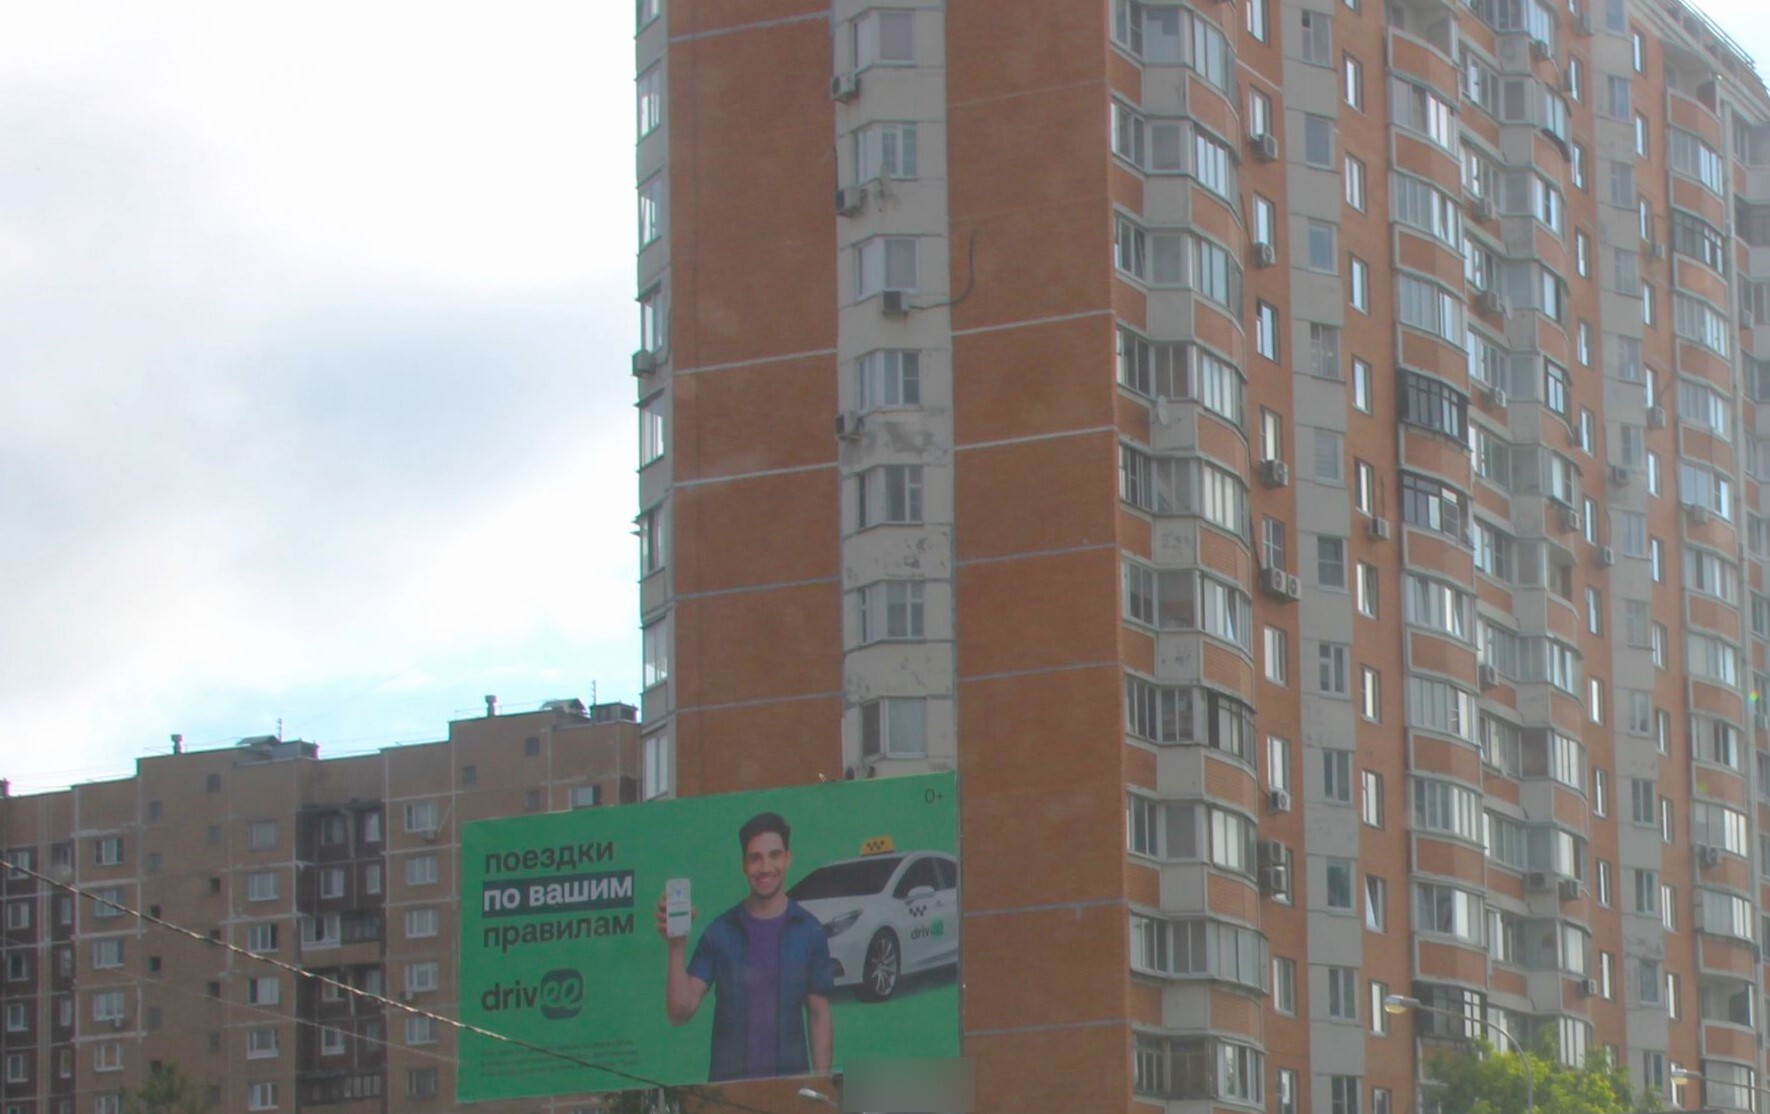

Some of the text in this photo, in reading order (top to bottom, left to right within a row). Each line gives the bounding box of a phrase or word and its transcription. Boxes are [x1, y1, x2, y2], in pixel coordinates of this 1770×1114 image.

[484, 841, 614, 875] поездки
[483, 876, 633, 912] по вашим
[483, 913, 635, 954] правилам
[481, 967, 584, 1020] drivee
